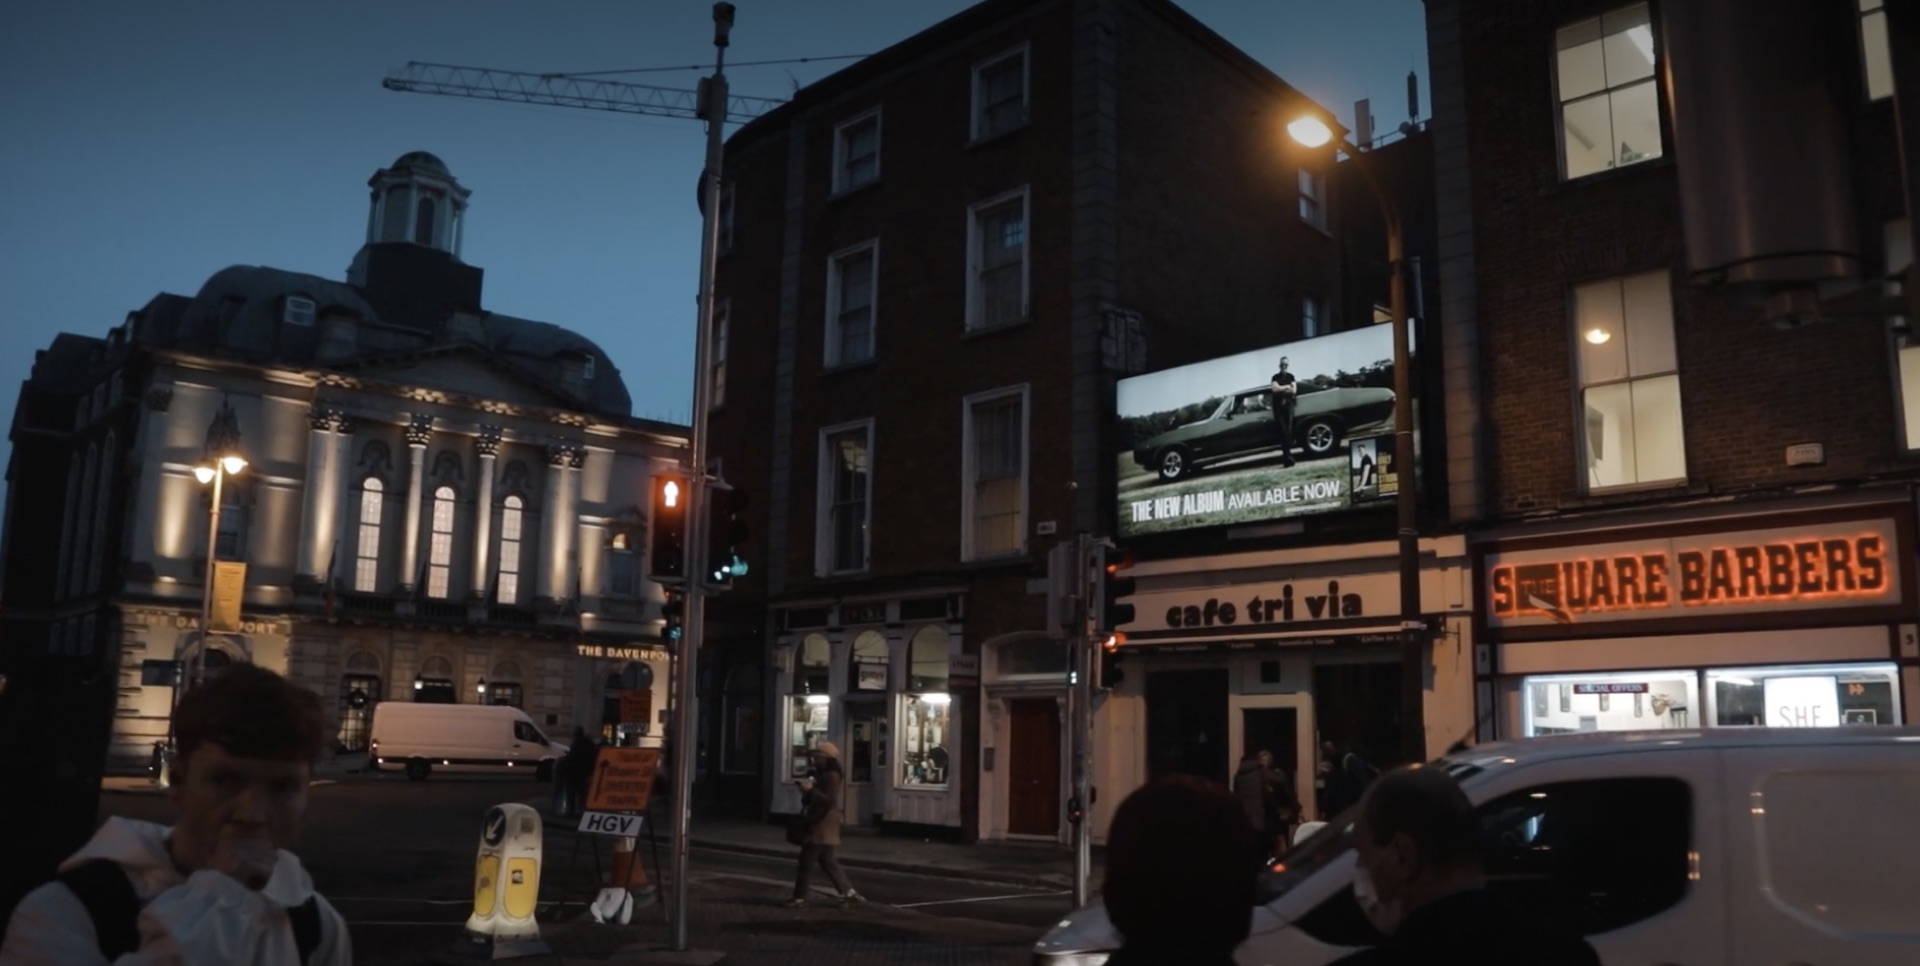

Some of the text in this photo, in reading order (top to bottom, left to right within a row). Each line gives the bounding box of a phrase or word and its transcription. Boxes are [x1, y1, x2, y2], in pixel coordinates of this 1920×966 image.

[1131, 500, 1153, 523] THE
[1154, 495, 1181, 519] NEW
[1183, 490, 1225, 516] ALBUM
[1228, 485, 1301, 510] AVAILABLE
[1303, 480, 1340, 500] NOW
[1678, 535, 1885, 603] BARBERS
[1166, 580, 1363, 628] cafe tri via
[577, 645, 603, 657] THE
[587, 814, 634, 833] HGV
